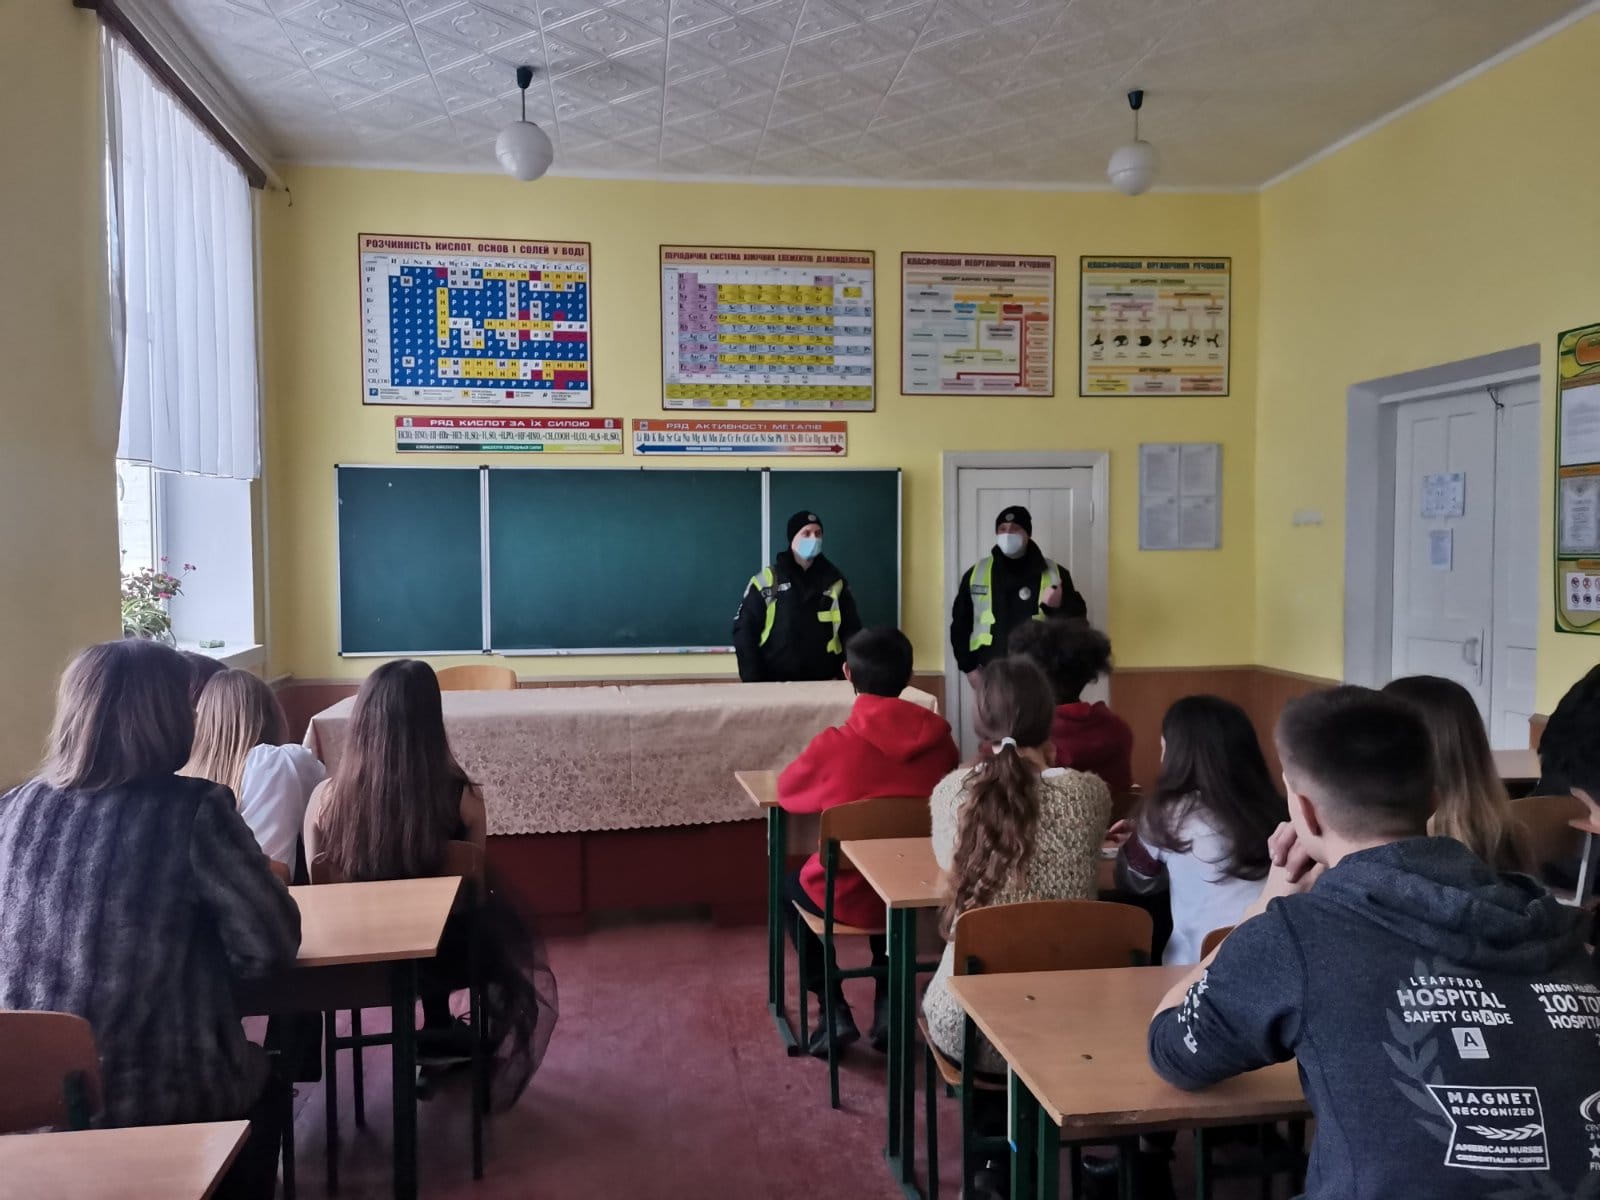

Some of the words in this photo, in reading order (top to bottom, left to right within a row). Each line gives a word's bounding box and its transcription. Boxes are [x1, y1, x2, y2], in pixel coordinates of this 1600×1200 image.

[366, 239, 431, 250] РОЗЧИННІСТЬ
[478, 243, 509, 253] ОСНОВ
[520, 245, 549, 255] СОЛЕЙ
[561, 247, 585, 257] ВОДІ
[430, 419, 454, 427] РЯД
[1409, 976, 1483, 989] LEAPFROG
[1530, 982, 1574, 994] Watson
[1396, 988, 1506, 1009] HOSPITAL
[1538, 994, 1579, 1013] 100
[1403, 1010, 1457, 1023] SAFETY
[1461, 1009, 1514, 1026] GRADE
[1464, 1031, 1479, 1048] A
[1446, 1091, 1532, 1105] MAGNET
[1451, 1106, 1535, 1117] RECOGNIZED
[1454, 1143, 1509, 1154] AMERICAN
[1509, 1145, 1544, 1154] NURSES
